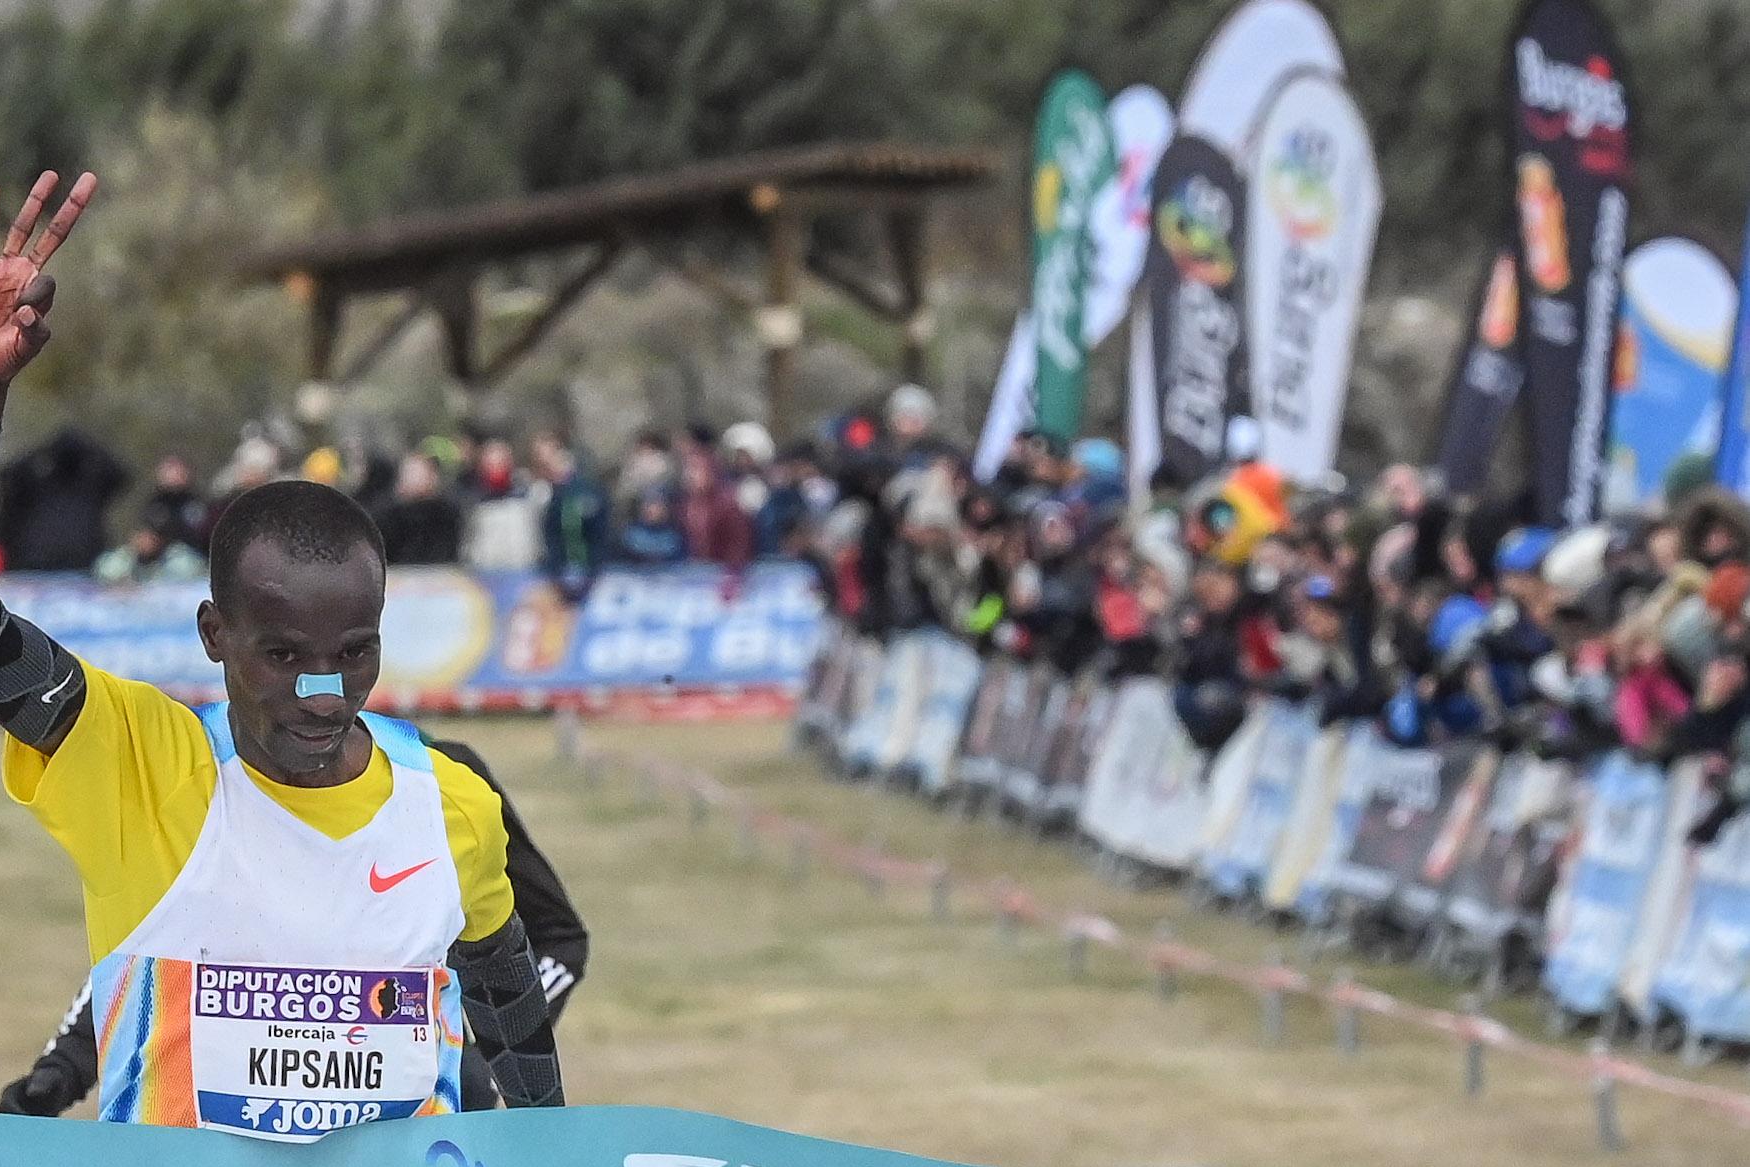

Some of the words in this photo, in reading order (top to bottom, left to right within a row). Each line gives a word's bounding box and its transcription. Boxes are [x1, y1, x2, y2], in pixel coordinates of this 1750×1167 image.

[200, 968, 362, 995] DIPUTACIÓN
[199, 989, 362, 1021] BURGOS
[267, 1024, 336, 1043] Ibercaja
[412, 1027, 428, 1042] 13
[249, 1047, 384, 1090] KIPSANG
[271, 1101, 382, 1133] Joma
